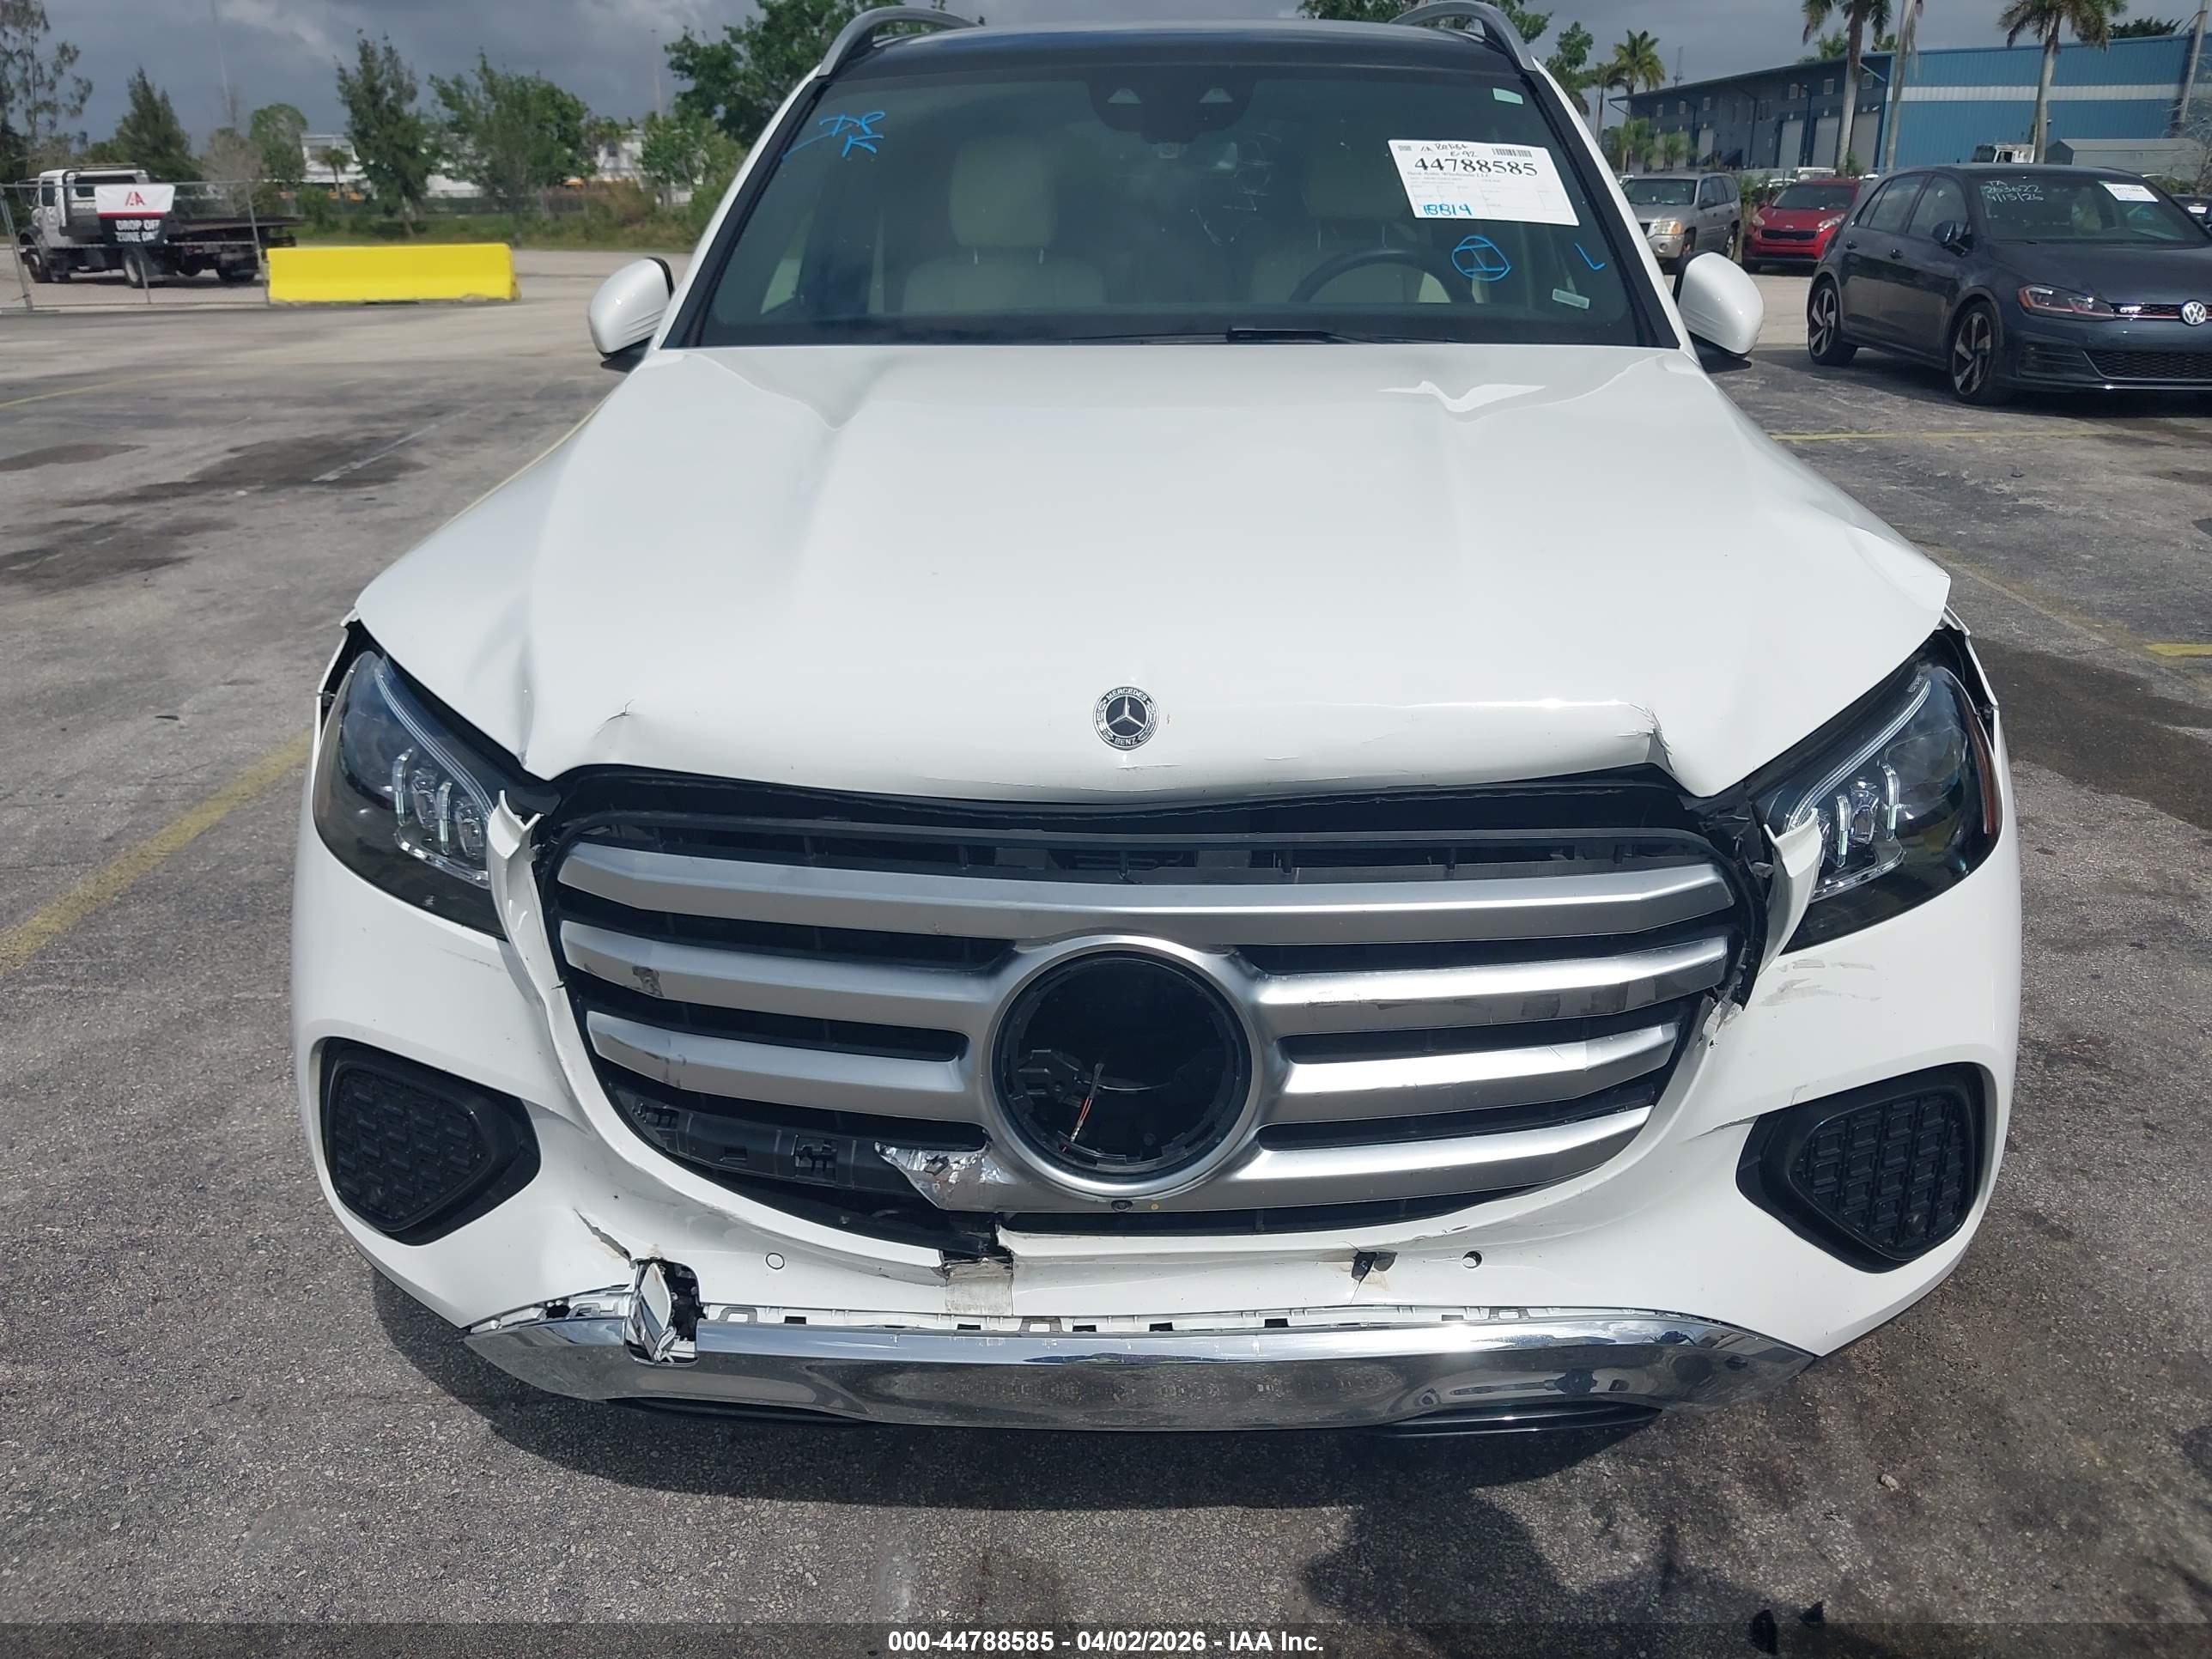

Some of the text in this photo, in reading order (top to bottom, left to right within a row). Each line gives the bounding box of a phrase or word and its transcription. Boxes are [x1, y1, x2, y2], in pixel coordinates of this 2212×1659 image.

[1414, 157, 1539, 177] 44788585
[115, 219, 143, 231] DROP
[115, 231, 142, 242] ZONE
[1105, 688, 1148, 702] MERCEDES
[1114, 737, 1138, 745] BENZ
